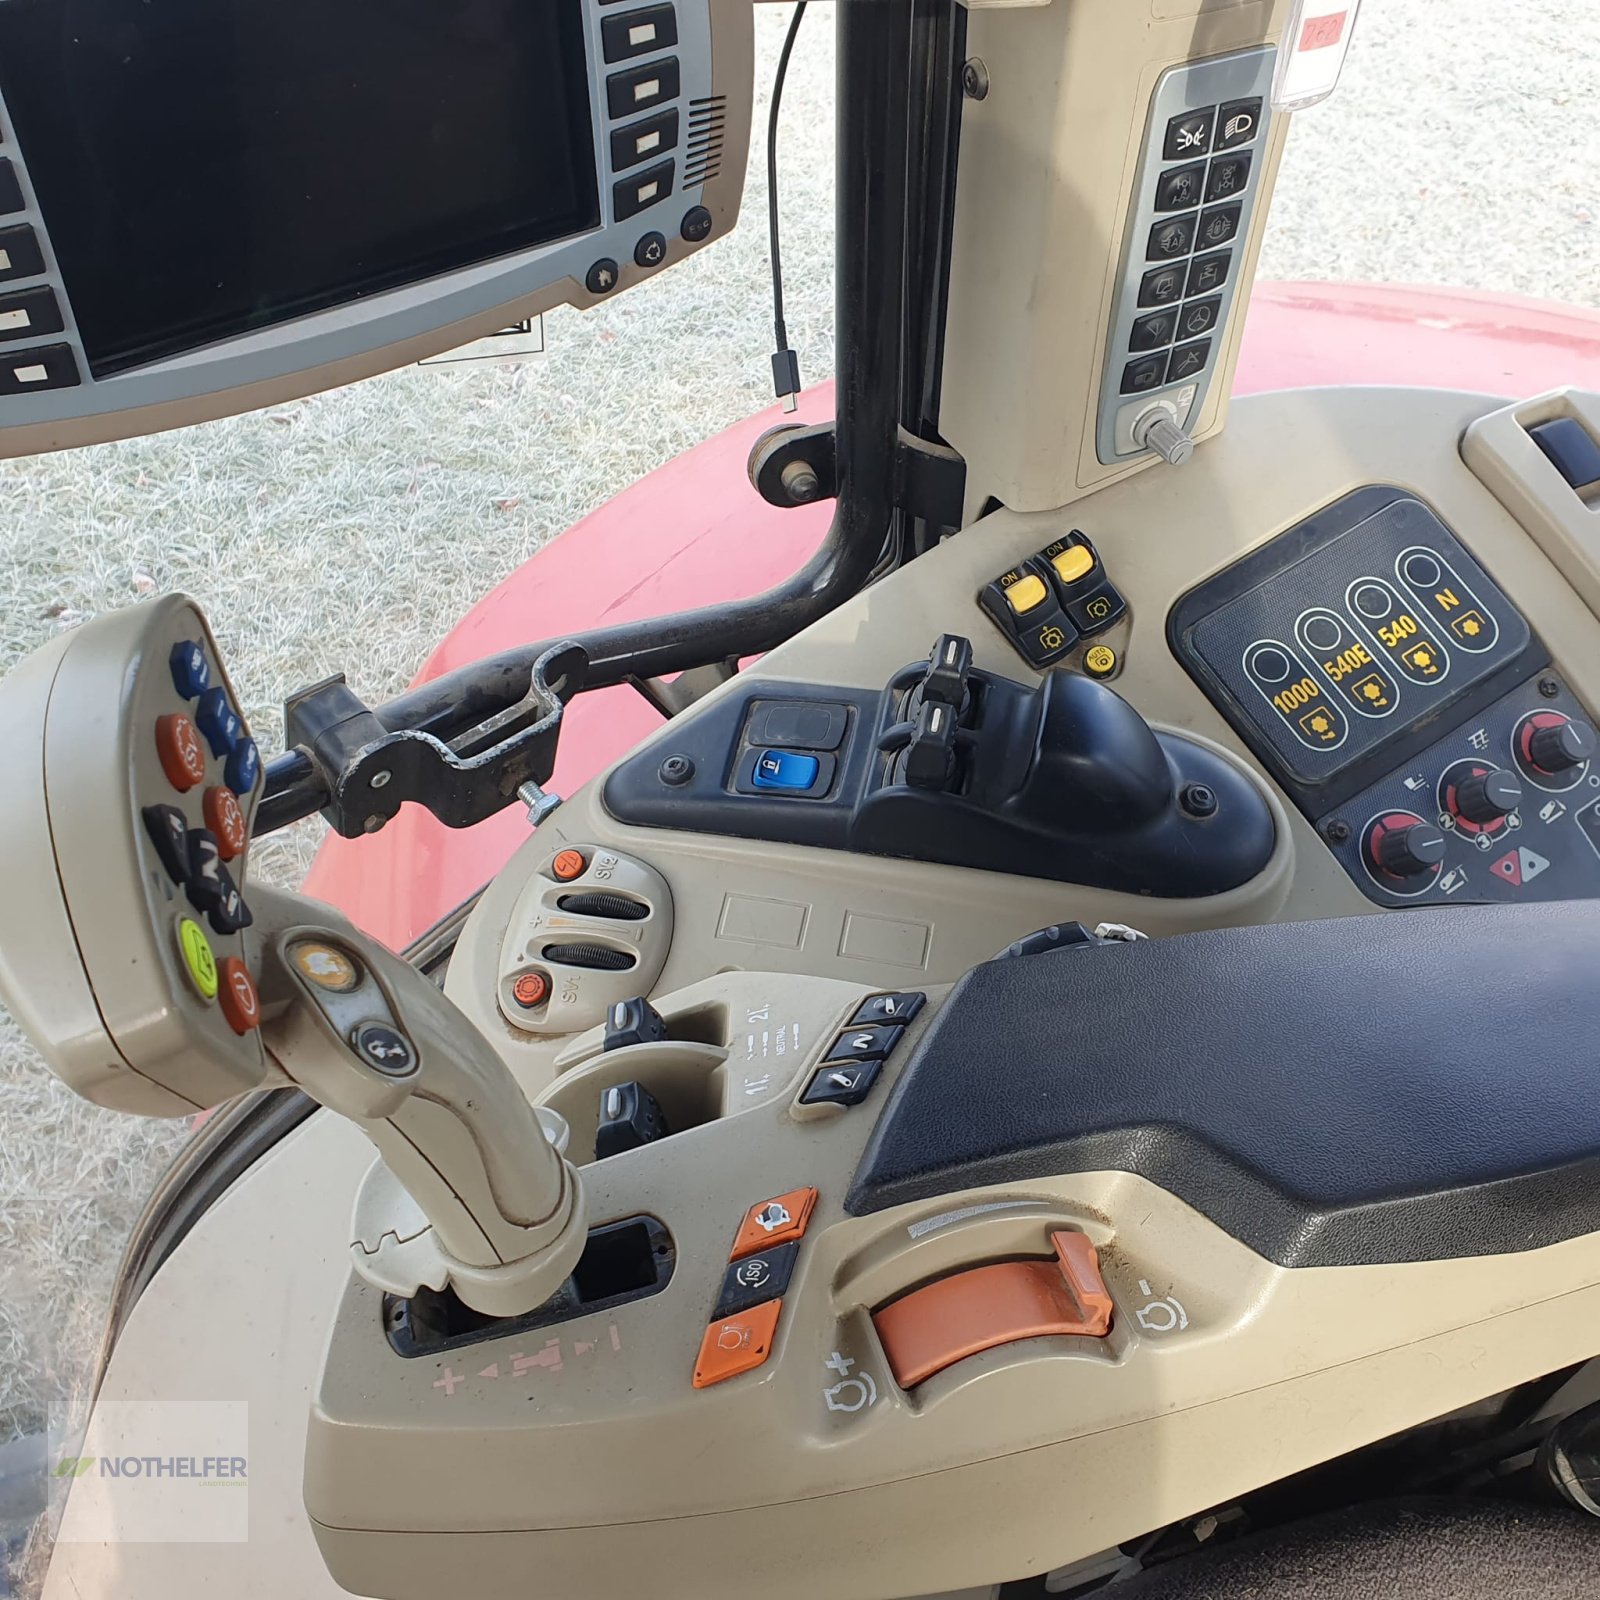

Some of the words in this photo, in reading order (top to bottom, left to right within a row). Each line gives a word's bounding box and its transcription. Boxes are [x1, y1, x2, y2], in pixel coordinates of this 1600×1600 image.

[1046, 542, 1064, 557] ON
[1001, 571, 1018, 586] ON
[1434, 587, 1460, 612] N
[1377, 614, 1418, 648] 540
[1089, 647, 1106, 662] AUTO
[1323, 643, 1372, 682] 540E
[1273, 677, 1319, 715] 1000
[1440, 814, 1454, 828] 2
[1480, 834, 1492, 849] 3
[595, 856, 619, 880] SV2
[562, 975, 581, 1004] SV1
[775, 1024, 786, 1057] NEUTRAL
[852, 1033, 874, 1049] N
[744, 1261, 764, 1281] ISO
